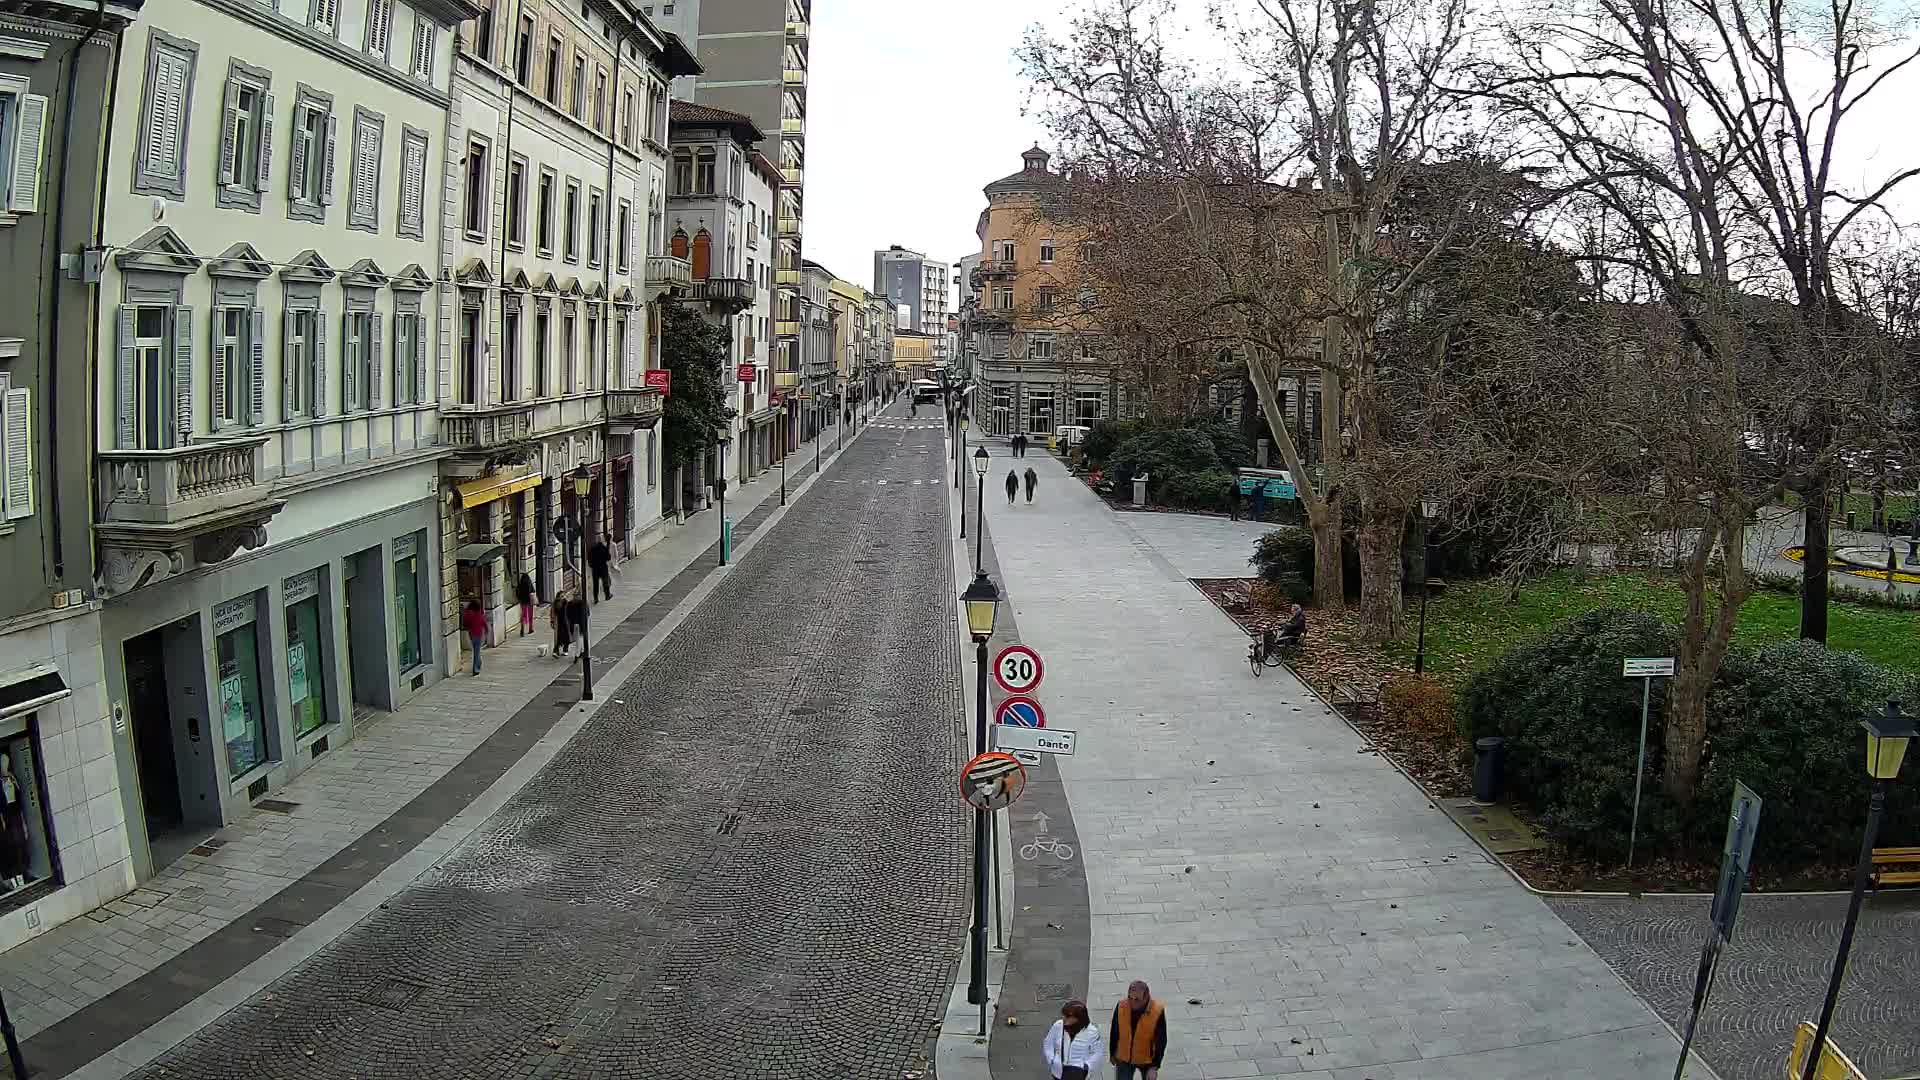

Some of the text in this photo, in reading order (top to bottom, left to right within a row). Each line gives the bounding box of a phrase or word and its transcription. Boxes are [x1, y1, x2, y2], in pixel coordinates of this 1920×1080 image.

[215, 612, 244, 628] OPERATIVO
[1005, 658, 1033, 681] 30
[1037, 738, 1070, 750] Dante
